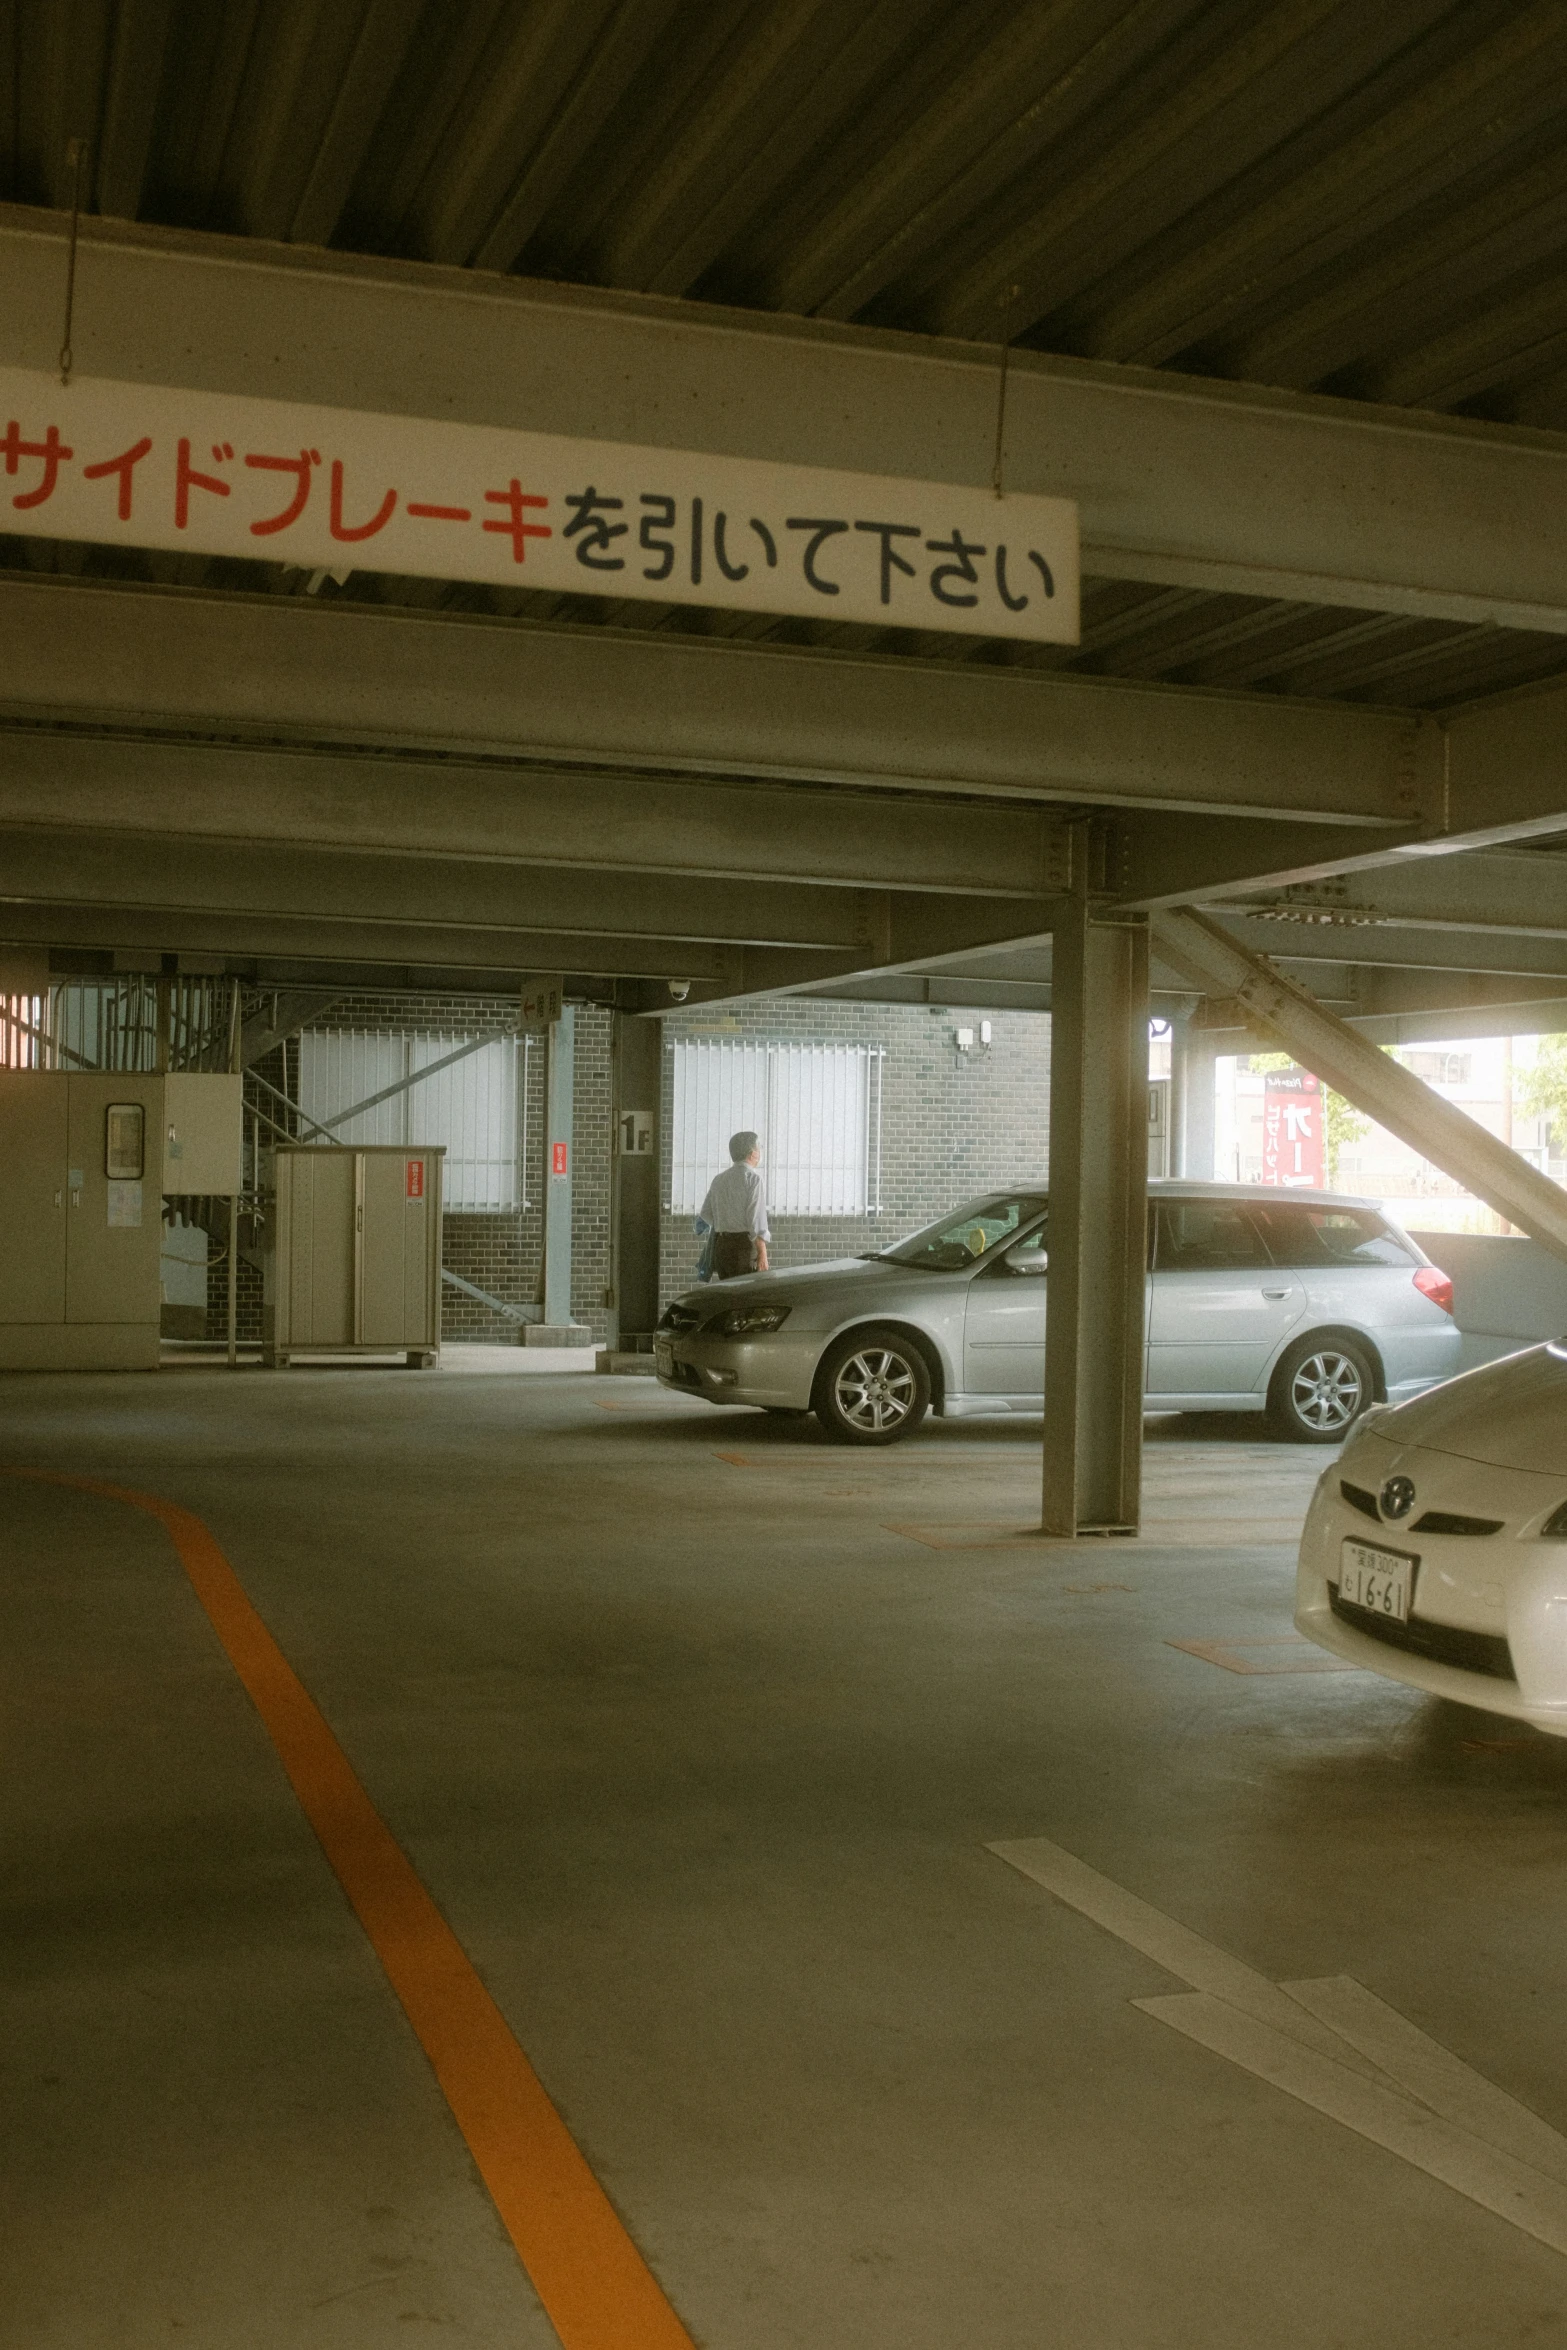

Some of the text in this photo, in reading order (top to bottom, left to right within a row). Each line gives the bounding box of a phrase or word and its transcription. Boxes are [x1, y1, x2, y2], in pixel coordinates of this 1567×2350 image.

[0, 420, 1054, 610] サイドブレーキを引いて下さい
[621, 1115, 649, 1151] 1F
